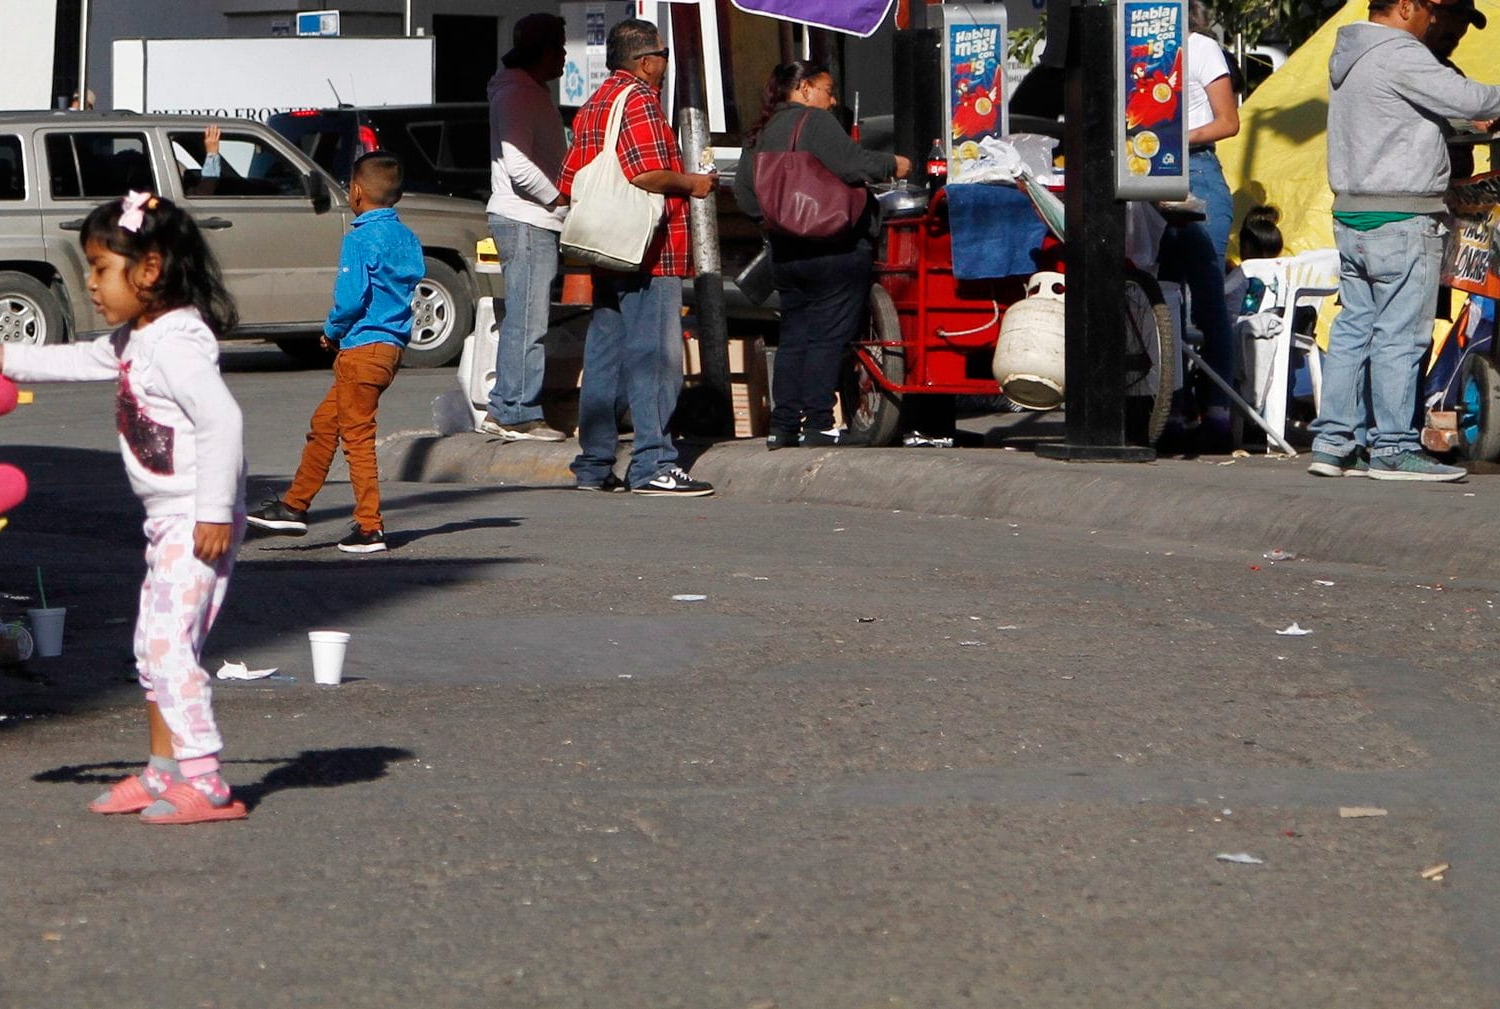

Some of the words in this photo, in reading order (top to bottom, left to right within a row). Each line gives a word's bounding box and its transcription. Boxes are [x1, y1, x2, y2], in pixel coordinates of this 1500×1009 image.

[1131, 6, 1170, 22] Habla
[956, 28, 991, 43] Habla
[1156, 32, 1175, 40] con
